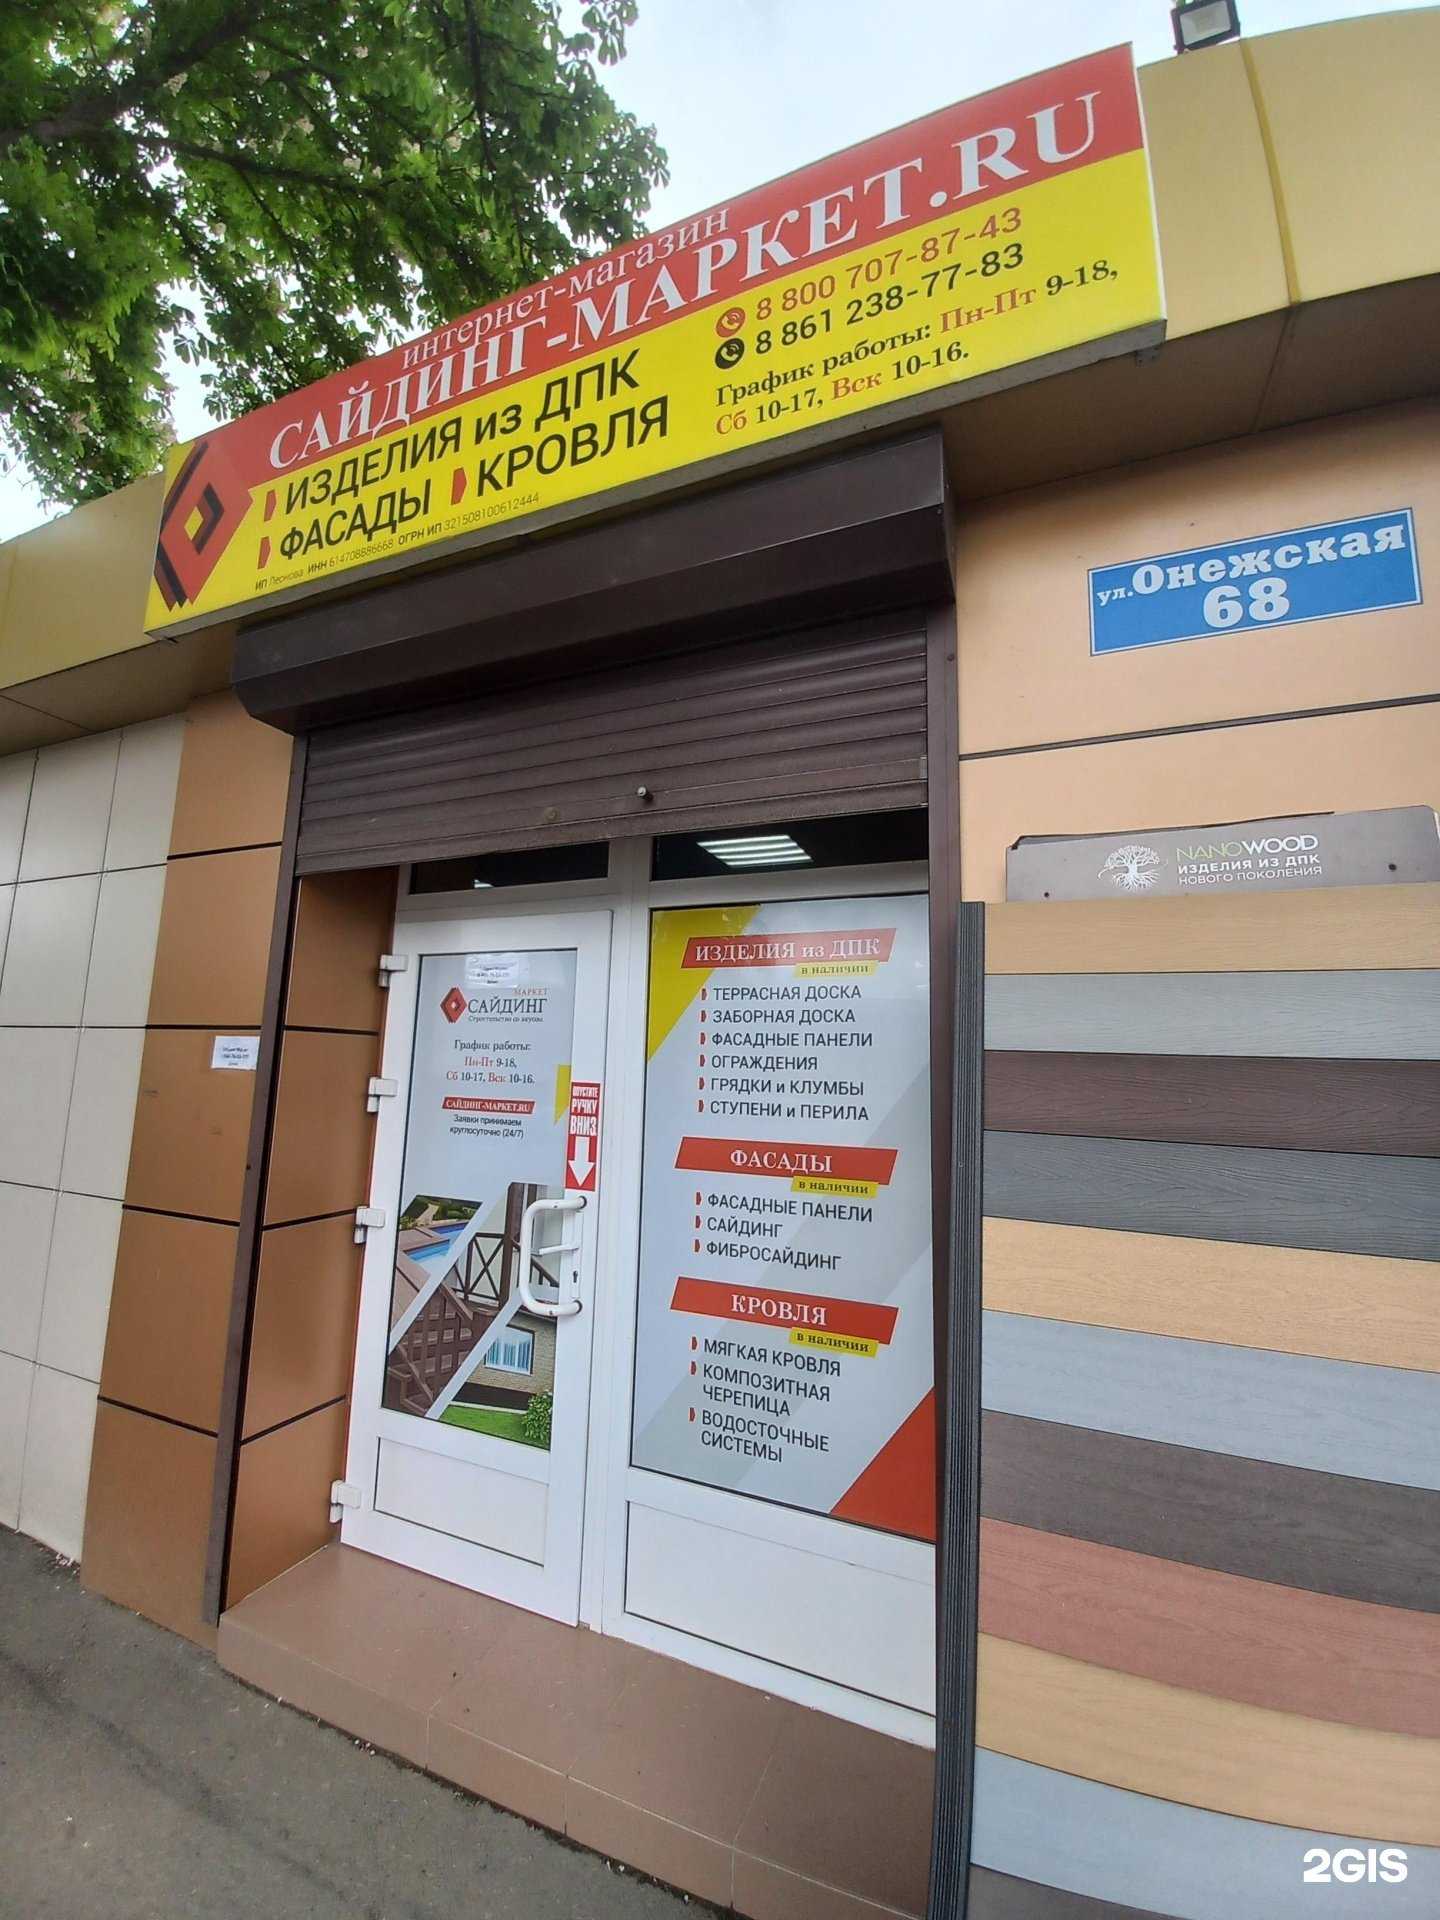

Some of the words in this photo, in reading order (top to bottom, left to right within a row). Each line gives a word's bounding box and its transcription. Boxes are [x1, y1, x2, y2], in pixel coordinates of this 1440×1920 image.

[756, 297, 772, 321] 8
[782, 275, 835, 312] 800
[845, 207, 1022, 290] 707-87-43
[269, 91, 1101, 471] САЙДИНГ-МАРКЕТ.RU
[401, 208, 729, 370] интернет-магазин
[755, 330, 772, 354] 8
[782, 308, 832, 345] 861
[846, 243, 1024, 326] 238-77-83
[716, 363, 815, 407] График
[822, 323, 930, 376] работы:
[940, 287, 1037, 335] Пн-Пт
[1046, 259, 1118, 296] 9-18,
[716, 409, 747, 435] Сб
[756, 388, 824, 424] 10-17,
[831, 372, 882, 400] Вск
[892, 341, 969, 381] 10-16.
[284, 416, 463, 515] ИЗДЕЛИЯ
[474, 403, 522, 446] из
[535, 349, 641, 428] ДПК
[280, 479, 432, 560] ФАСАДЫ
[476, 396, 669, 497] КРОВЛЯ
[255, 579, 268, 591] ИП
[308, 559, 327, 575] ИНН
[398, 529, 425, 546] ОГРН
[427, 522, 442, 537] ИП
[1203, 577, 1290, 628] 68
[1176, 835, 1319, 862] NANOWOOD
[1178, 860, 1252, 874] ИЗДЕЛИЯ
[1259, 857, 1279, 868] ИЗ
[1285, 854, 1321, 868] ДПК
[1179, 873, 1233, 885] НОВОГО
[1238, 866, 1322, 881] ПОКОЛЕНИЯ
[696, 943, 795, 962] ИЗДЕЛИЯ
[802, 946, 825, 958] из
[829, 938, 881, 959] ДПК
[812, 965, 869, 975] наличии
[713, 986, 800, 1001] ТЕРРАСНАЯ
[804, 985, 861, 1002] ДОСКА
[468, 996, 548, 1016] САЙДИНГ
[712, 1010, 795, 1023] ЗАБОРНАЯ
[799, 1009, 856, 1025] ДОСКА
[454, 1039, 490, 1052] График
[493, 1040, 531, 1052] работы:
[712, 1032, 799, 1048] ФАСАДНЫЕ
[804, 1033, 873, 1047] ПАНЕЛИ
[464, 1056, 494, 1067] Пн-Пт
[711, 1055, 818, 1072] ОГРАЖДЕНИЯ
[446, 1071, 458, 1081] Сб
[711, 1078, 772, 1094] ГРЯДКИ
[777, 1083, 785, 1093] и
[790, 1081, 864, 1095] КЛУМБЫ
[571, 1098, 598, 1114] РУЧКУ
[710, 1100, 782, 1116] СТУПЕНИ
[786, 1107, 795, 1118] и
[800, 1104, 869, 1121] ПЕРИЛА
[453, 1114, 479, 1124] Заявки
[570, 1115, 596, 1136] ВНИЗ
[503, 1128, 524, 1138] (24/7)
[730, 1149, 833, 1174] ФАСАДЫ
[799, 1181, 806, 1189] в
[809, 1182, 869, 1194] наличии
[707, 1193, 797, 1215] ФАСАДНЫЕ
[802, 1202, 873, 1222] ПАНЕЛИ
[707, 1215, 783, 1238] САЙДИНГ
[706, 1241, 841, 1270] ФИБРОСАЙДИНГ
[731, 1294, 827, 1326] КРОВЛЯ
[797, 1332, 804, 1342] в
[807, 1334, 869, 1353] наличии
[704, 1338, 767, 1363] МЯГКАЯ
[772, 1351, 841, 1377] КРОВЛЯ
[703, 1364, 830, 1402] КОМПОЗИТНАЯ
[703, 1385, 790, 1417] ЧЕРЕПИЦА
[702, 1410, 830, 1452] ВОДОСТОЧНЫЕ
[701, 1431, 783, 1462] СИСТЕМЫ
